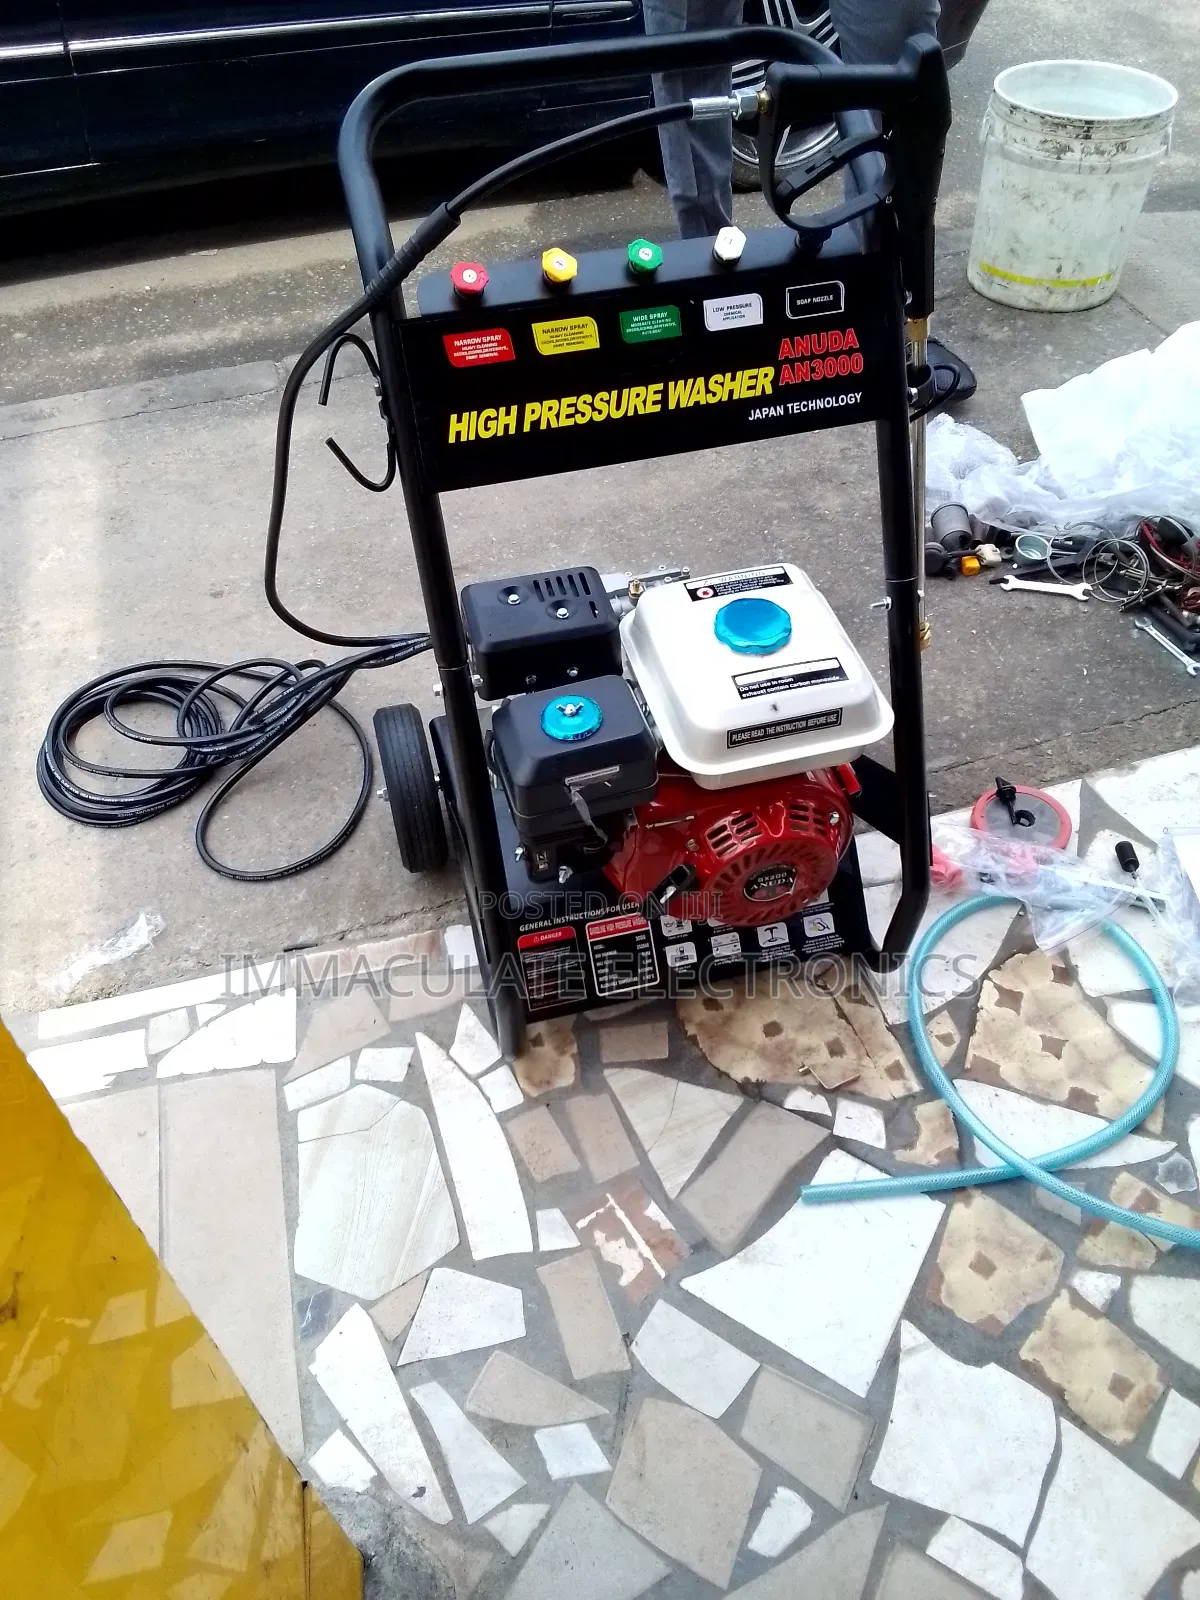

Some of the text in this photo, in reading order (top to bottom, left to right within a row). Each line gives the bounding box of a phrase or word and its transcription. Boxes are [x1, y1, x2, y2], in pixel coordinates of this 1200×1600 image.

[726, 302, 752, 310] PRESSURE
[796, 294, 834, 306] SOAP NOZZLE
[632, 312, 668, 322] WIDE SPRAY
[542, 326, 568, 334] NARROW
[454, 334, 502, 346] NARROW SPRAY
[778, 328, 860, 360] ANUDA
[778, 352, 864, 386] AN3000
[448, 366, 774, 443] HIGH PRESSURE WASHER
[748, 392, 862, 420] JAPAN TECHNOLOGY
[732, 714, 838, 742] PLEASE READ THE INSTRUCTION BEFORE USE
[750, 876, 794, 890] ANUDA
[520, 920, 552, 932] GENERAL
[553, 908, 606, 924] INSTRUCTIONS
[606, 904, 620, 914] FOR
[540, 932, 562, 941] DANGER
